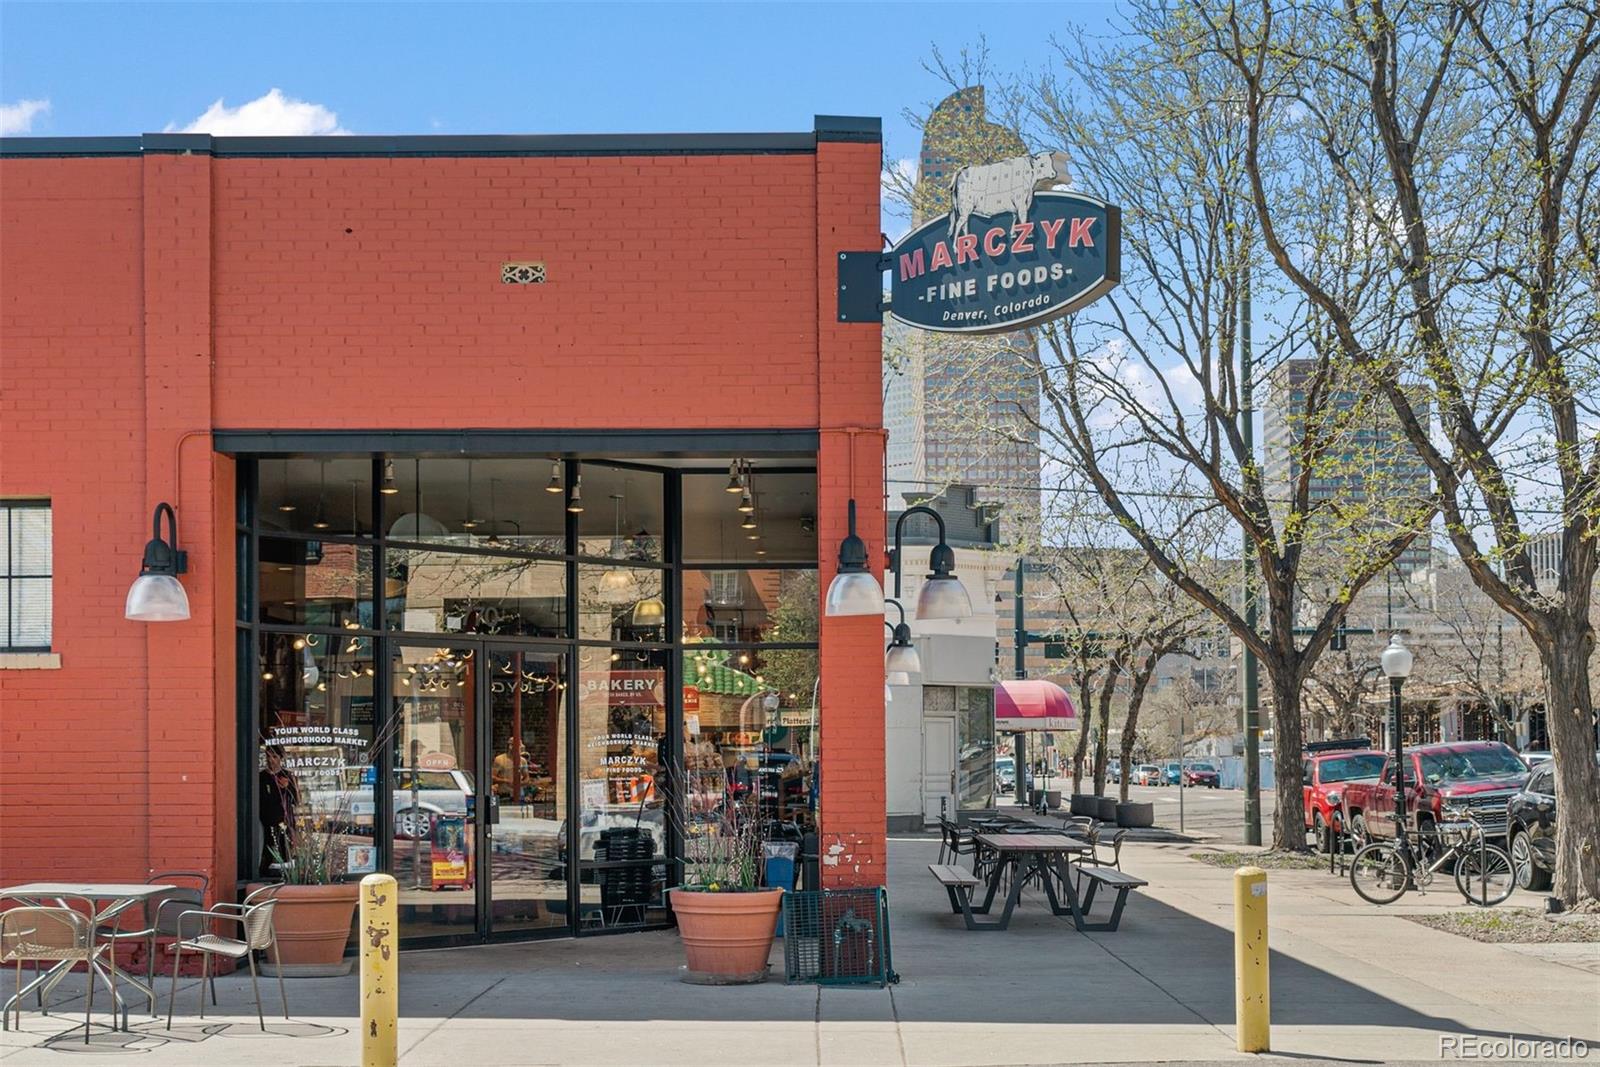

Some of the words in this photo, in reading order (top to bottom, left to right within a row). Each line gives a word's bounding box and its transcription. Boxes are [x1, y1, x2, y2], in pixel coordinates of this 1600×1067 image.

[900, 217, 1097, 282] MARCZYK
[943, 310, 988, 321] Denver,
[994, 295, 1050, 316] Colorado
[587, 679, 655, 690] BAKERY
[274, 727, 299, 735] YOUR
[300, 726, 330, 734] WORLD
[332, 727, 359, 736] CLASS
[265, 736, 332, 746] NEIGHBORHOOD
[334, 737, 368, 747] MARKET
[635, 740, 659, 748] MARKET
[286, 757, 346, 768] MARCZYK
[600, 756, 646, 765] MARCZYK
